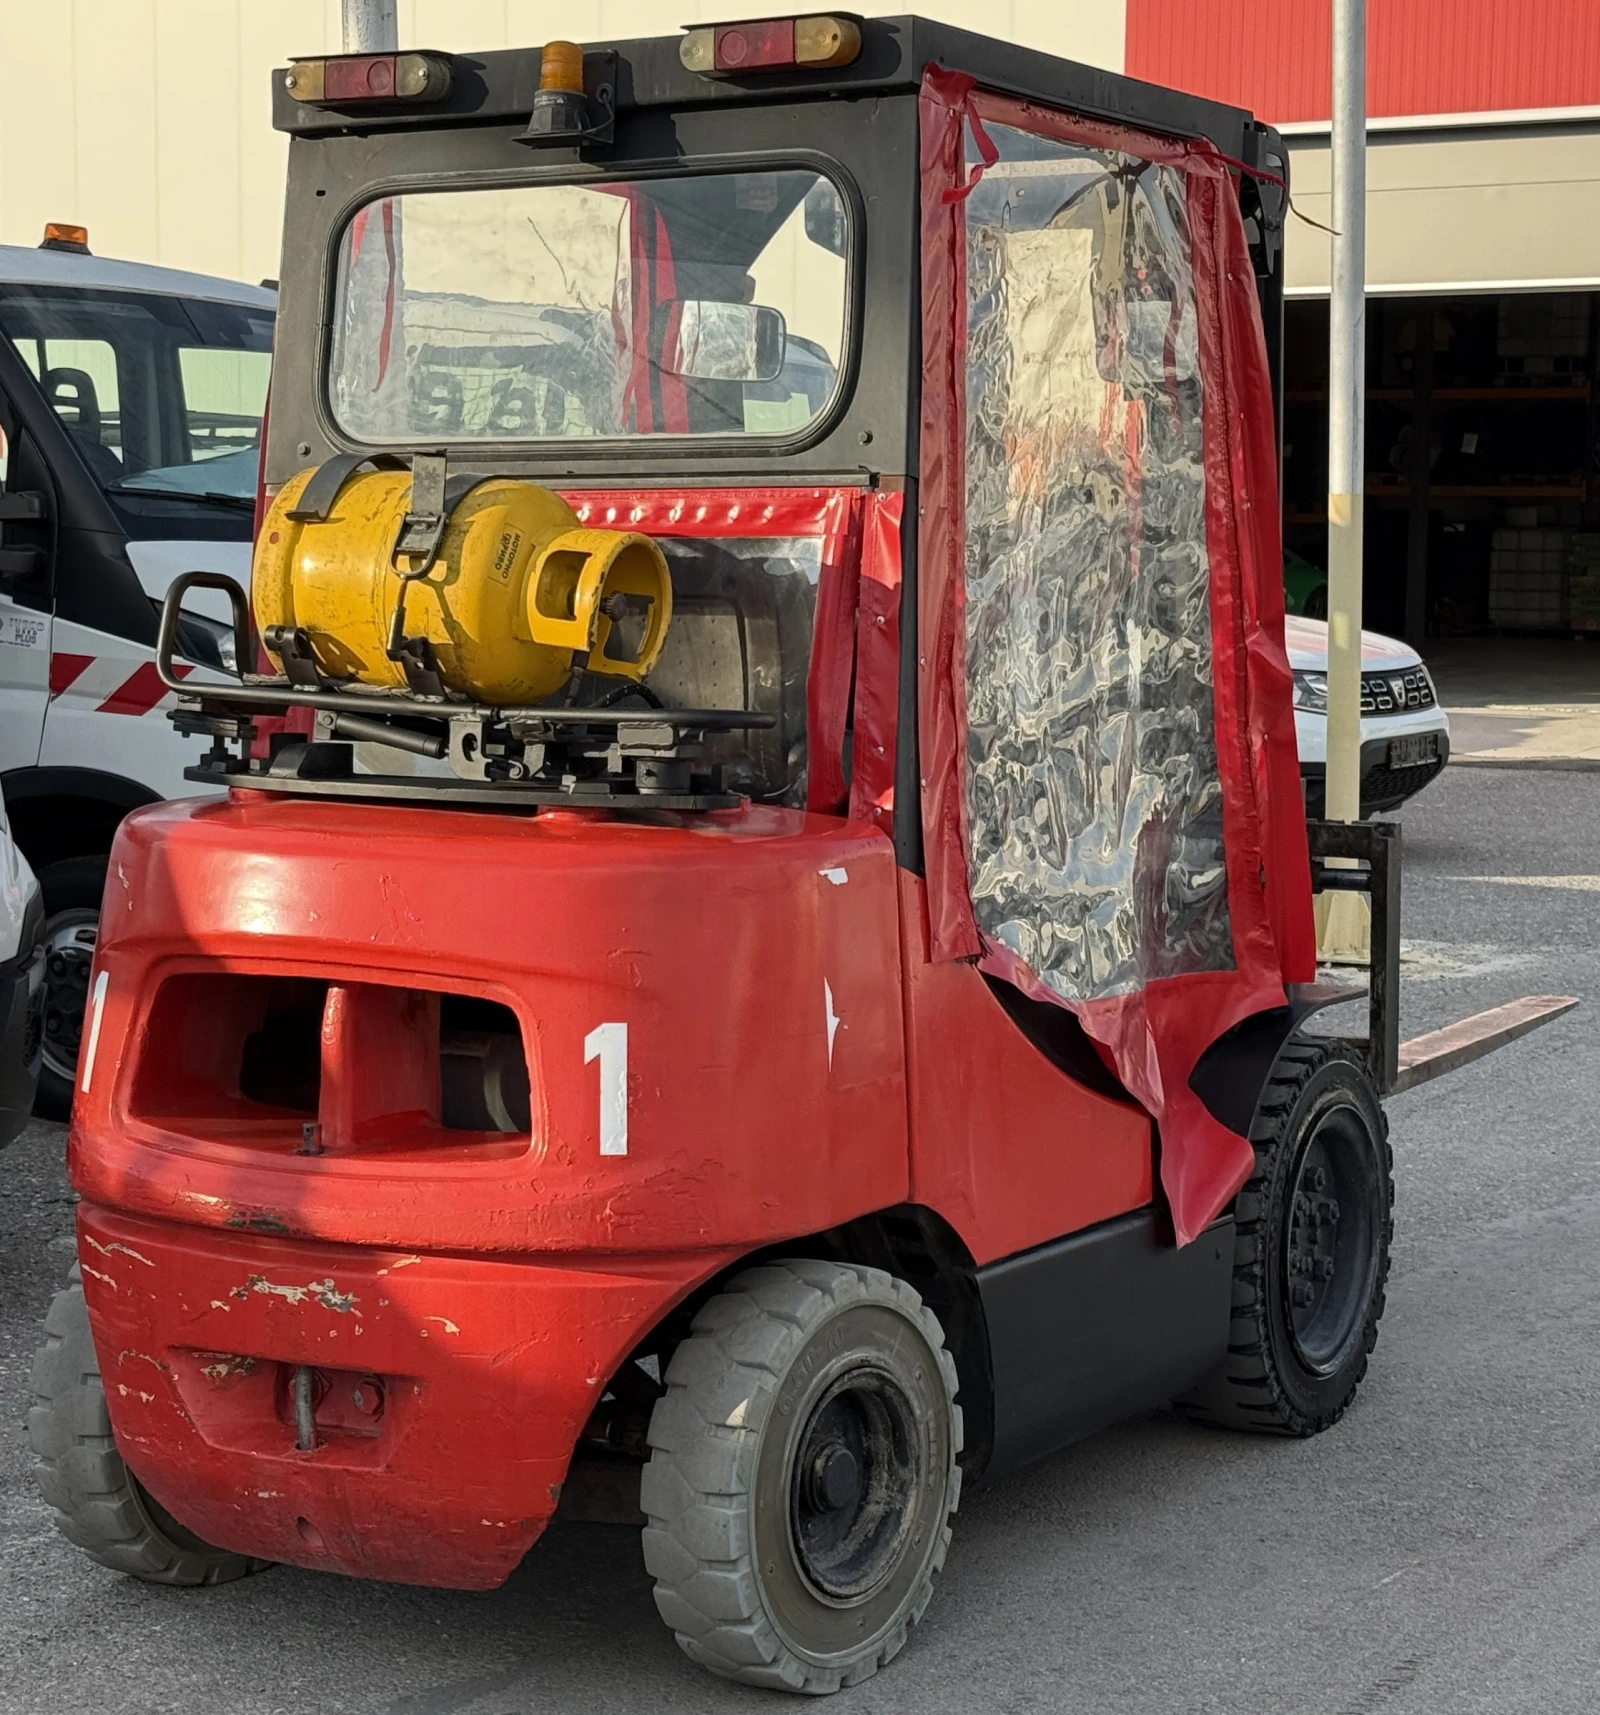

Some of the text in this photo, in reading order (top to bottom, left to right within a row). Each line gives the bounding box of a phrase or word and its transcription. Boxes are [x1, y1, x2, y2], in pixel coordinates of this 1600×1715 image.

[494, 533, 512, 571] ГОРИВО
[501, 532, 521, 579] МОТОРНО
[15, 634, 37, 645] PLUS
[81, 970, 109, 1094] 1
[584, 1022, 628, 1155] 1
